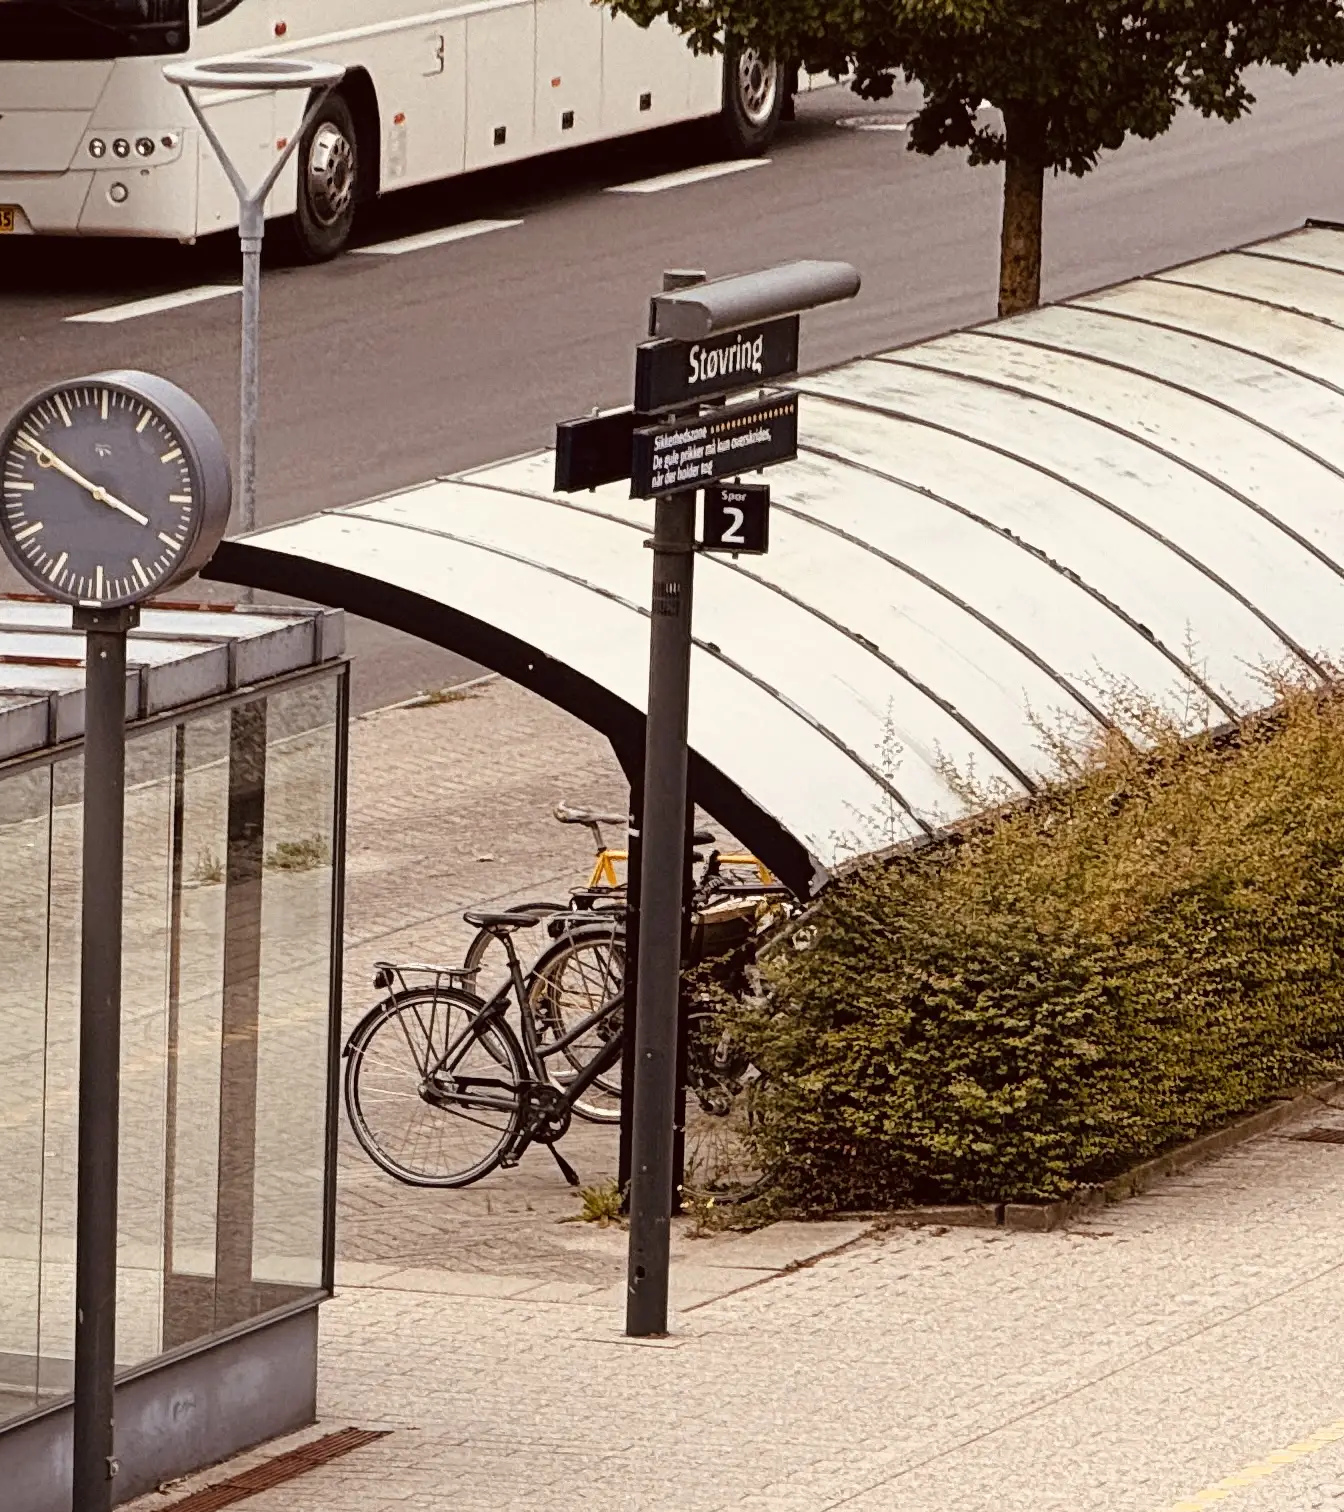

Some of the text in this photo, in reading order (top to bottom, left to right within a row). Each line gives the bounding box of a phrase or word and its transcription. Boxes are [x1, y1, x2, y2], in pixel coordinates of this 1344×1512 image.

[688, 334, 764, 383] Støvring
[652, 454, 663, 471] De
[721, 490, 747, 502] Spor
[721, 507, 745, 543] 2
